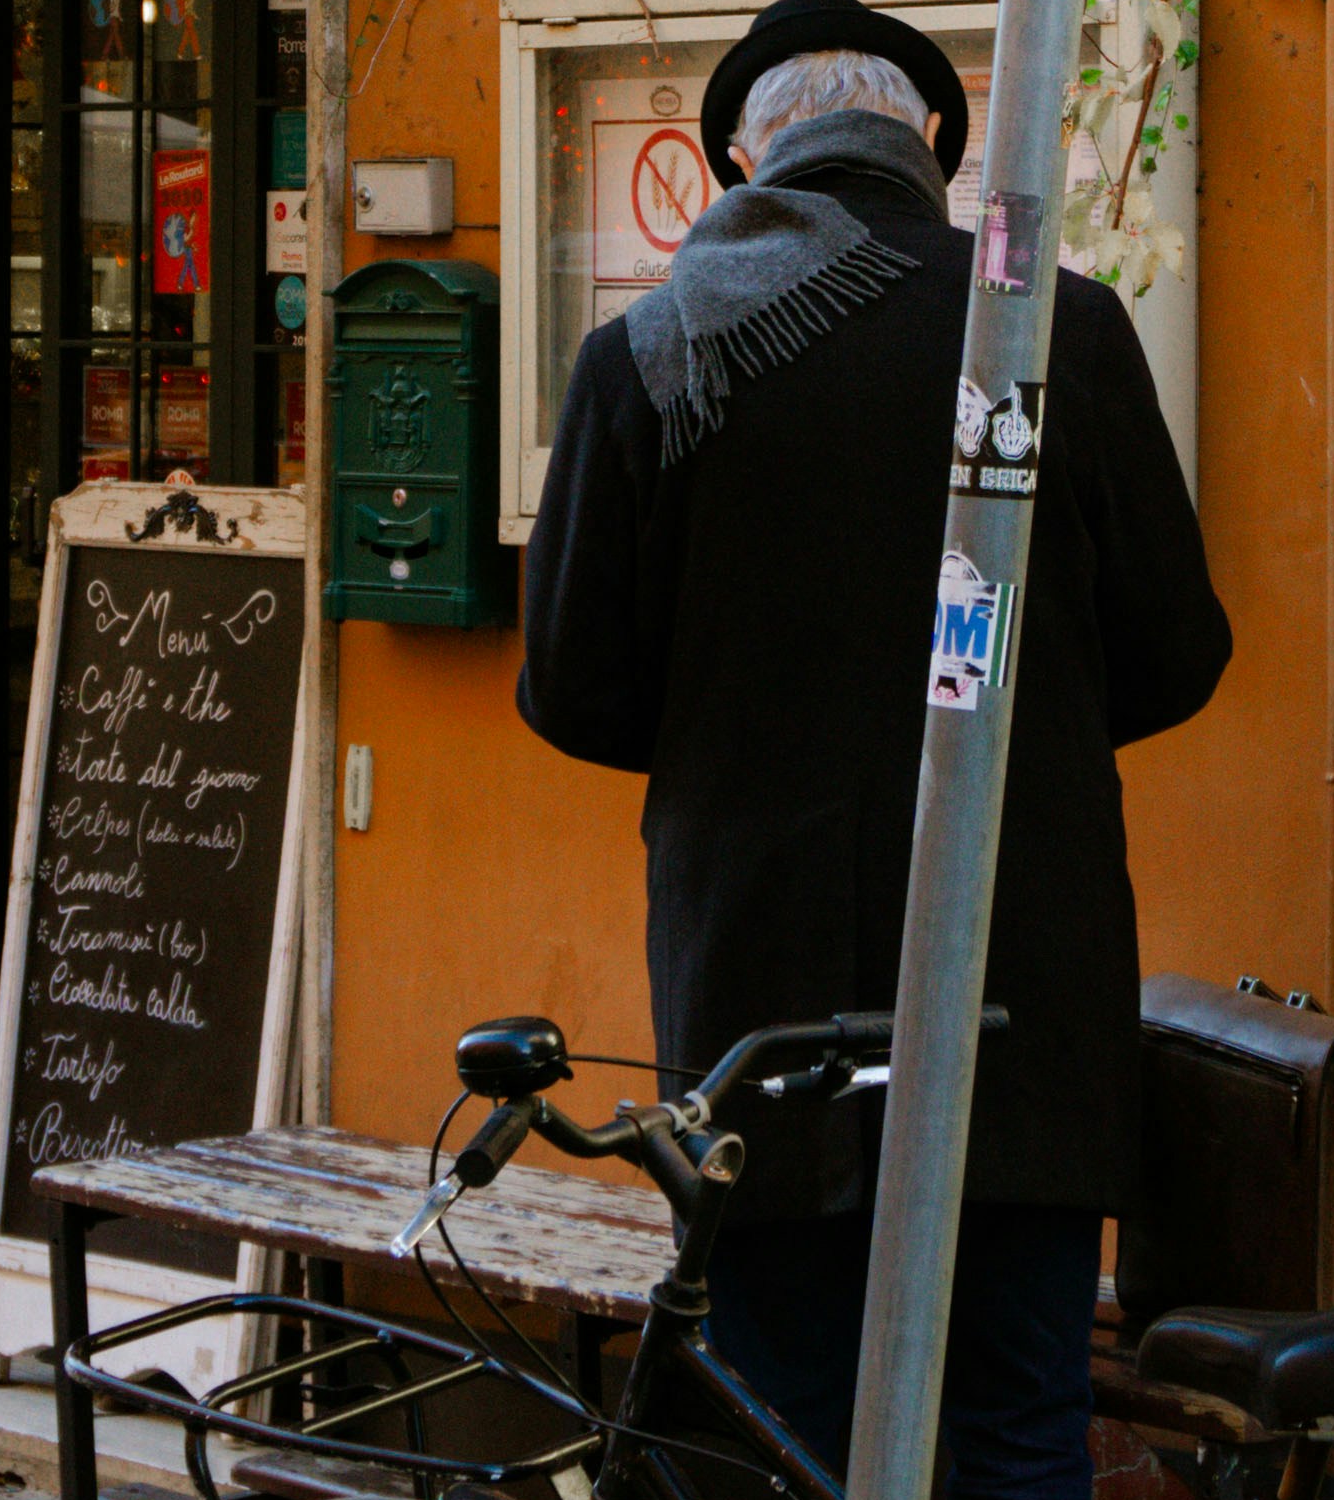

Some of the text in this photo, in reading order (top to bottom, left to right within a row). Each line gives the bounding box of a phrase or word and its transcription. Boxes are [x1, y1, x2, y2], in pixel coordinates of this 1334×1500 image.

[92, 405, 124, 421] ROMA
[168, 406, 201, 423] ROMA
[163, 692, 174, 712] e
[180, 665, 231, 722] the
[137, 742, 183, 788] del
[185, 767, 261, 810] giorno
[50, 855, 147, 899] Cannoli
[158, 920, 206, 967] (bio)
[41, 1032, 126, 1102] Tartufo
